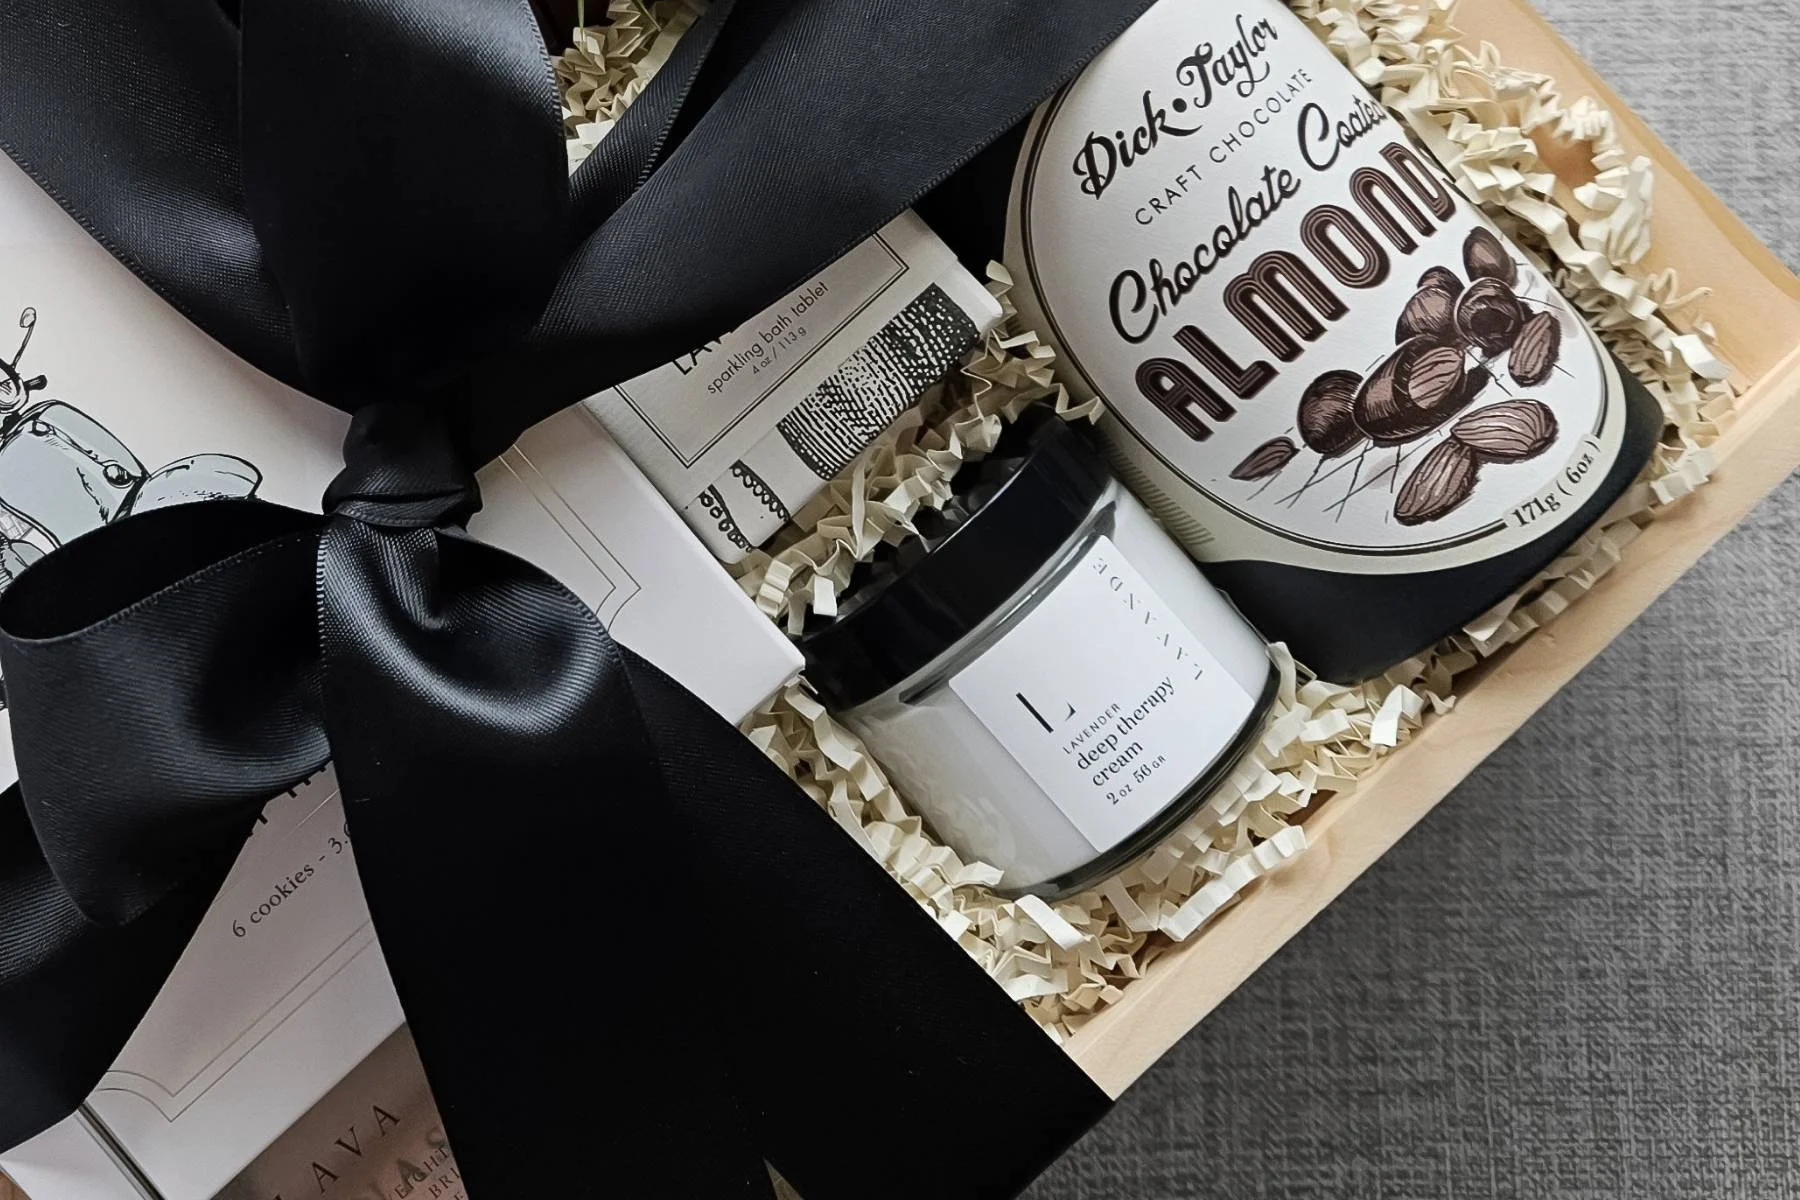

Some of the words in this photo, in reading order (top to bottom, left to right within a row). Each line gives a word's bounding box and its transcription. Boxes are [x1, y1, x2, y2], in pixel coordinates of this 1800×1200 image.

[1072, 90, 1203, 200] Dick
[1175, 13, 1279, 109] Taylor
[1134, 164, 1203, 226] CRAFT
[1208, 67, 1313, 164] CHOCOLATE
[1108, 165, 1301, 345] Chocolate
[707, 342, 764, 395] sparkling
[758, 314, 793, 344] bath
[790, 281, 829, 317] tablet
[752, 365, 760, 375] 4
[760, 356, 773, 368] oz
[778, 330, 797, 350] 113
[797, 326, 807, 337] g
[1511, 493, 1562, 528] 171g
[1062, 702, 1121, 755] LAVENDER
[1077, 733, 1119, 771] deep
[1116, 676, 1175, 736] therapy
[1092, 741, 1144, 787] cream
[1105, 791, 1119, 805] 2
[1119, 783, 1133, 798] oz
[232, 919, 246, 938] 6
[250, 863, 315, 924] cookies
[272, 1104, 401, 1200] AVA
